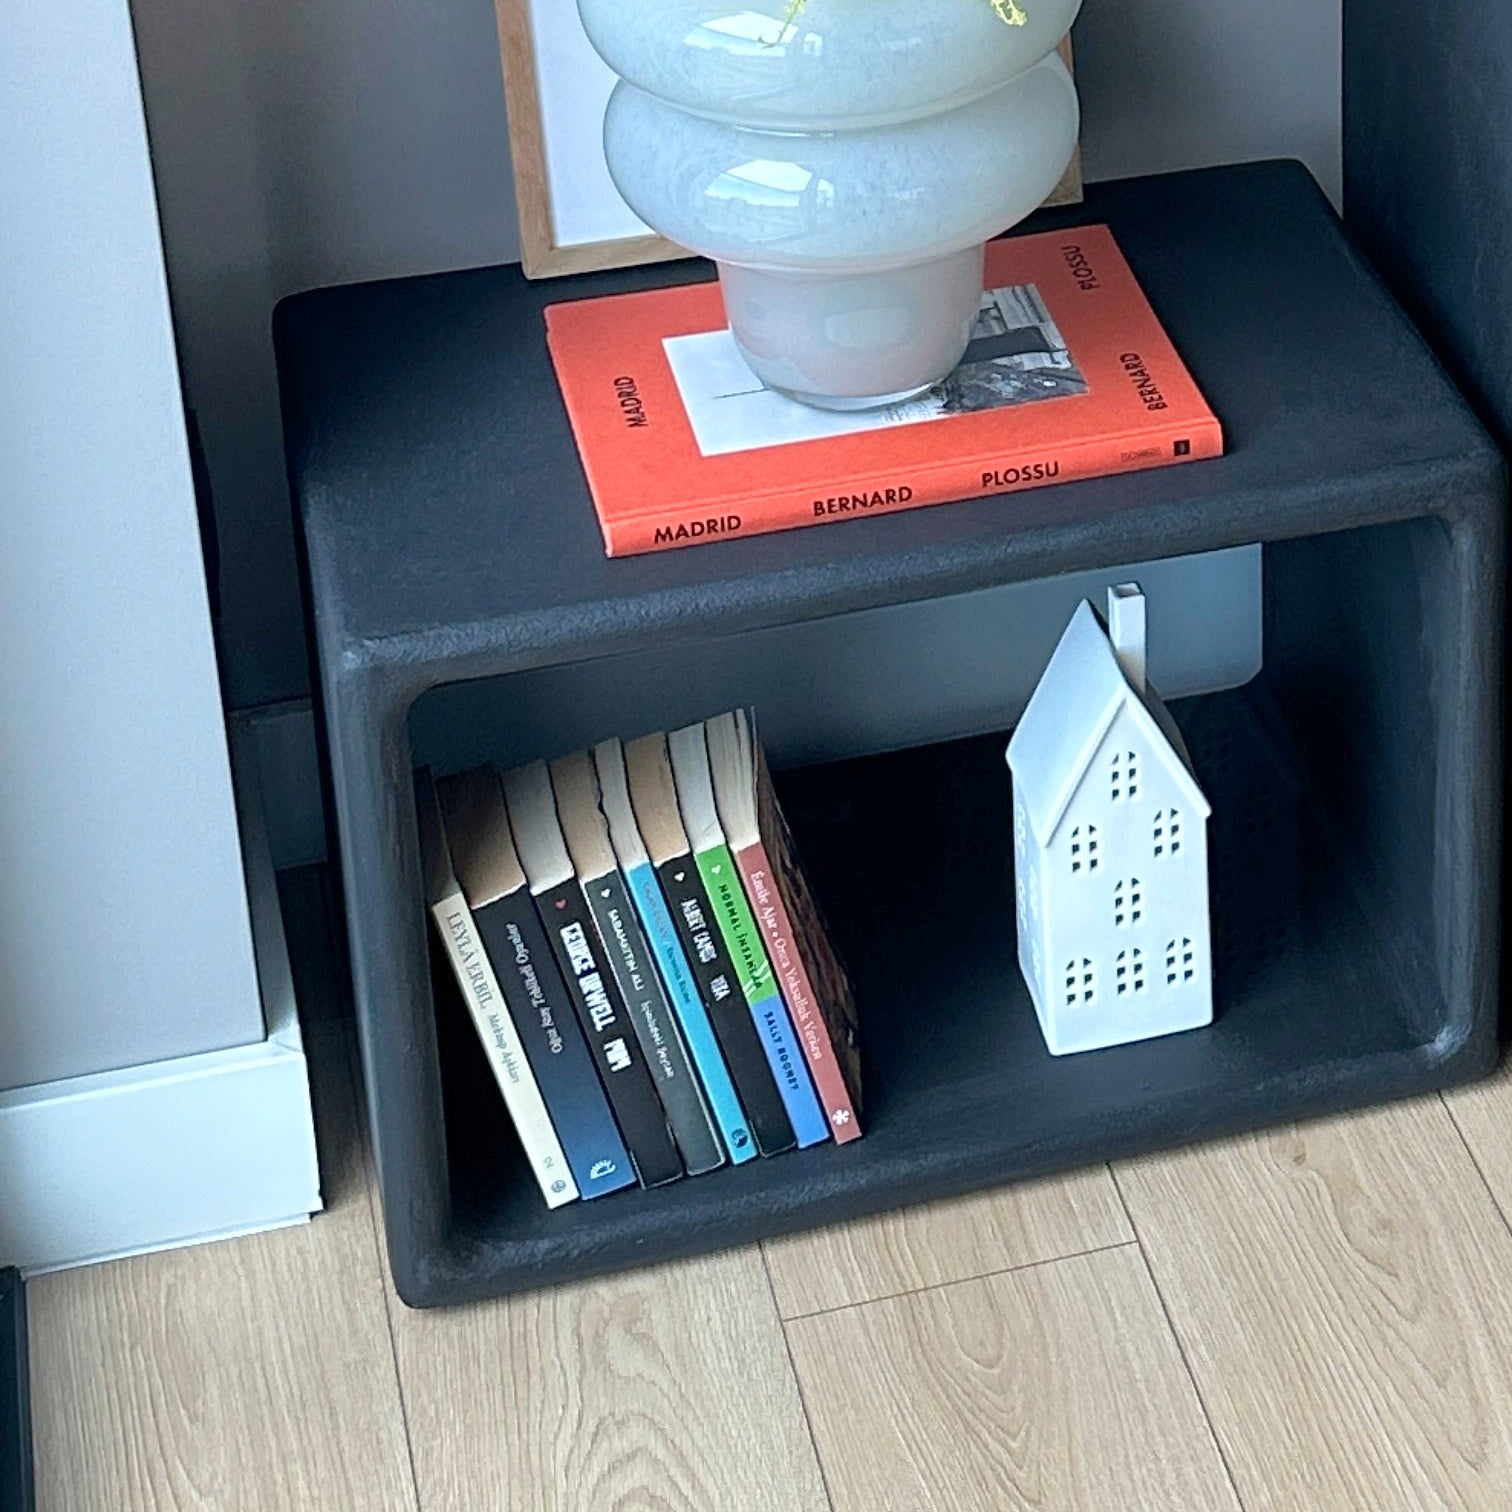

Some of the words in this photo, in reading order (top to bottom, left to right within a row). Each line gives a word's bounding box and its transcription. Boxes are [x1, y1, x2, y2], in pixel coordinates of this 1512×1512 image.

[1060, 244, 1097, 291] PLOSSU
[613, 374, 649, 429] MADRID
[1119, 350, 1169, 412] BERNARD
[653, 514, 742, 544] MADRID
[812, 485, 913, 517] BERNARD
[980, 461, 1060, 488] PLOSSU
[505, 922, 530, 965] Oyunlar
[680, 898, 707, 932] ALBERT
[692, 929, 718, 964] CAMUS
[718, 884, 742, 932] NORMAL
[736, 931, 763, 990] İNSANLAR
[447, 911, 477, 967] LEYLÂ
[467, 960, 495, 1009] ERBİL
[559, 920, 597, 976] GEORGE
[578, 971, 617, 1033] ORWELL
[773, 938, 790, 970] Onca
[803, 1021, 823, 1061] Varken
[763, 1010, 783, 1043] SALLY
[777, 1047, 800, 1091] ROONEY
